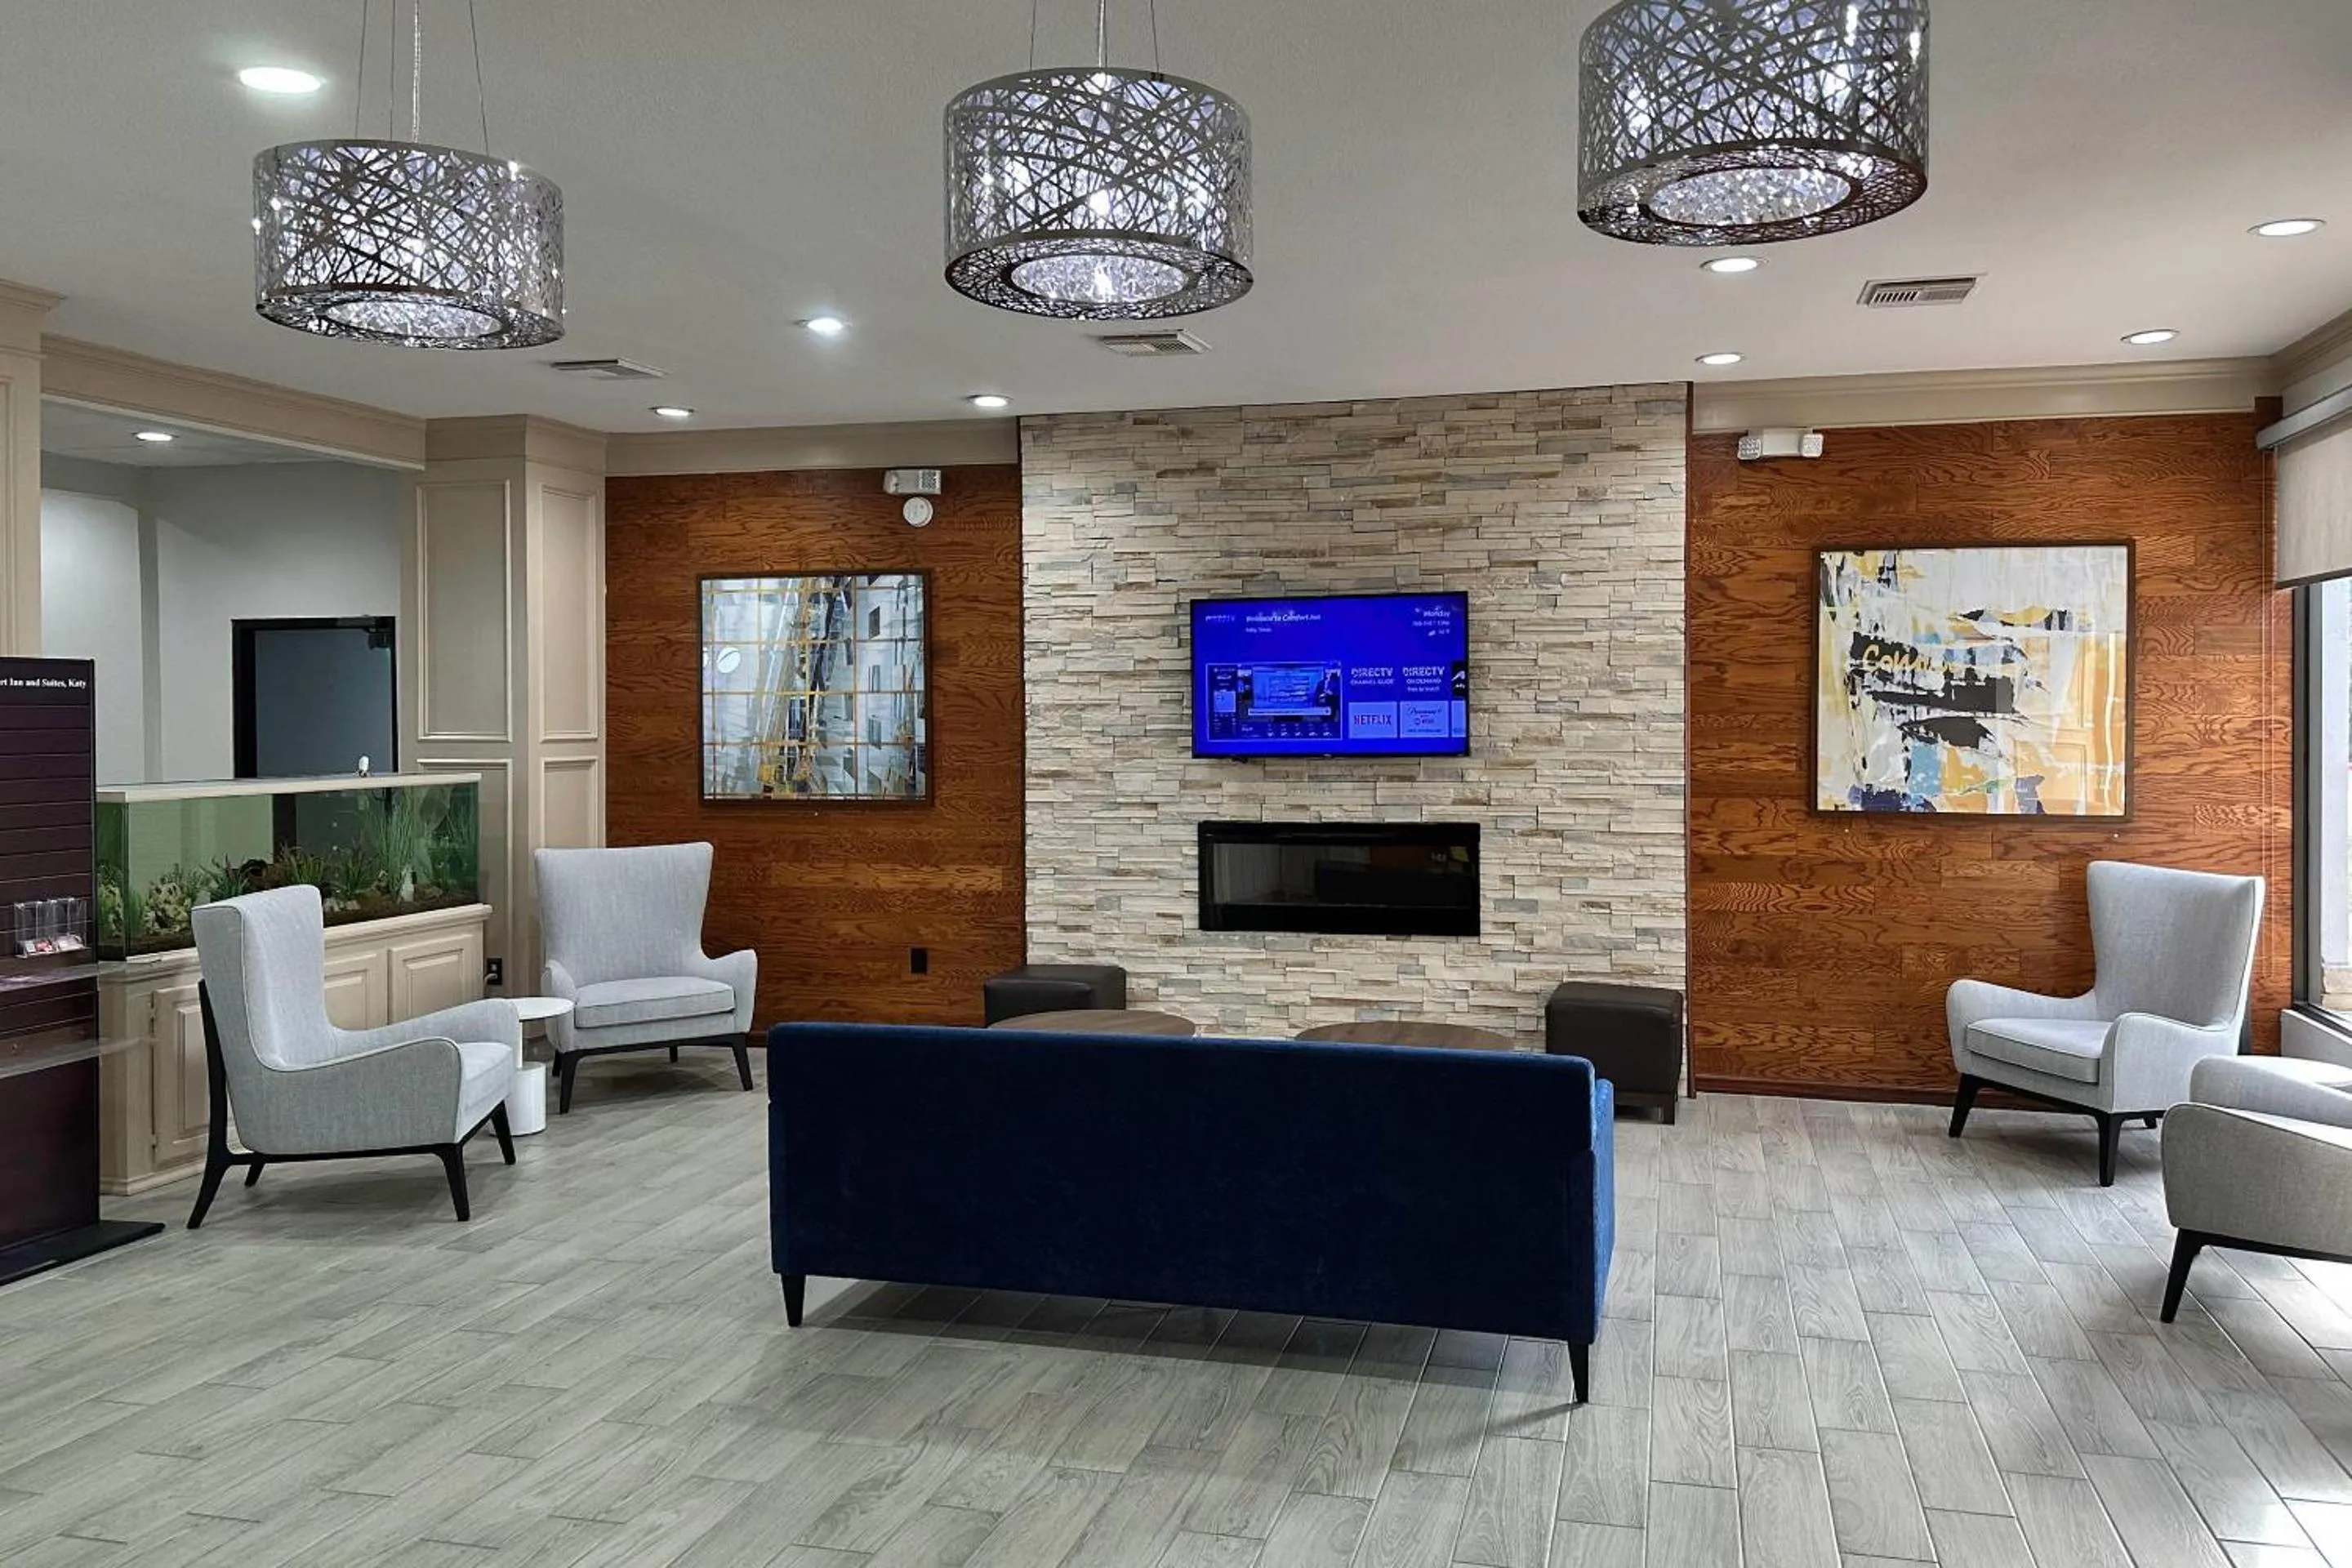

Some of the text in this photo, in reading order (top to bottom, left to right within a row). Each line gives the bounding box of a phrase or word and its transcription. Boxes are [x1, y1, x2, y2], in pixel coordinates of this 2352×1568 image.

[1351, 667, 1393, 678] DIRECTV
[1402, 666, 1445, 677] DIRECTV
[10, 678, 24, 686] Inn
[42, 679, 67, 688] Suites,
[69, 679, 86, 689] Katy
[1354, 715, 1392, 725] NETFLIX
